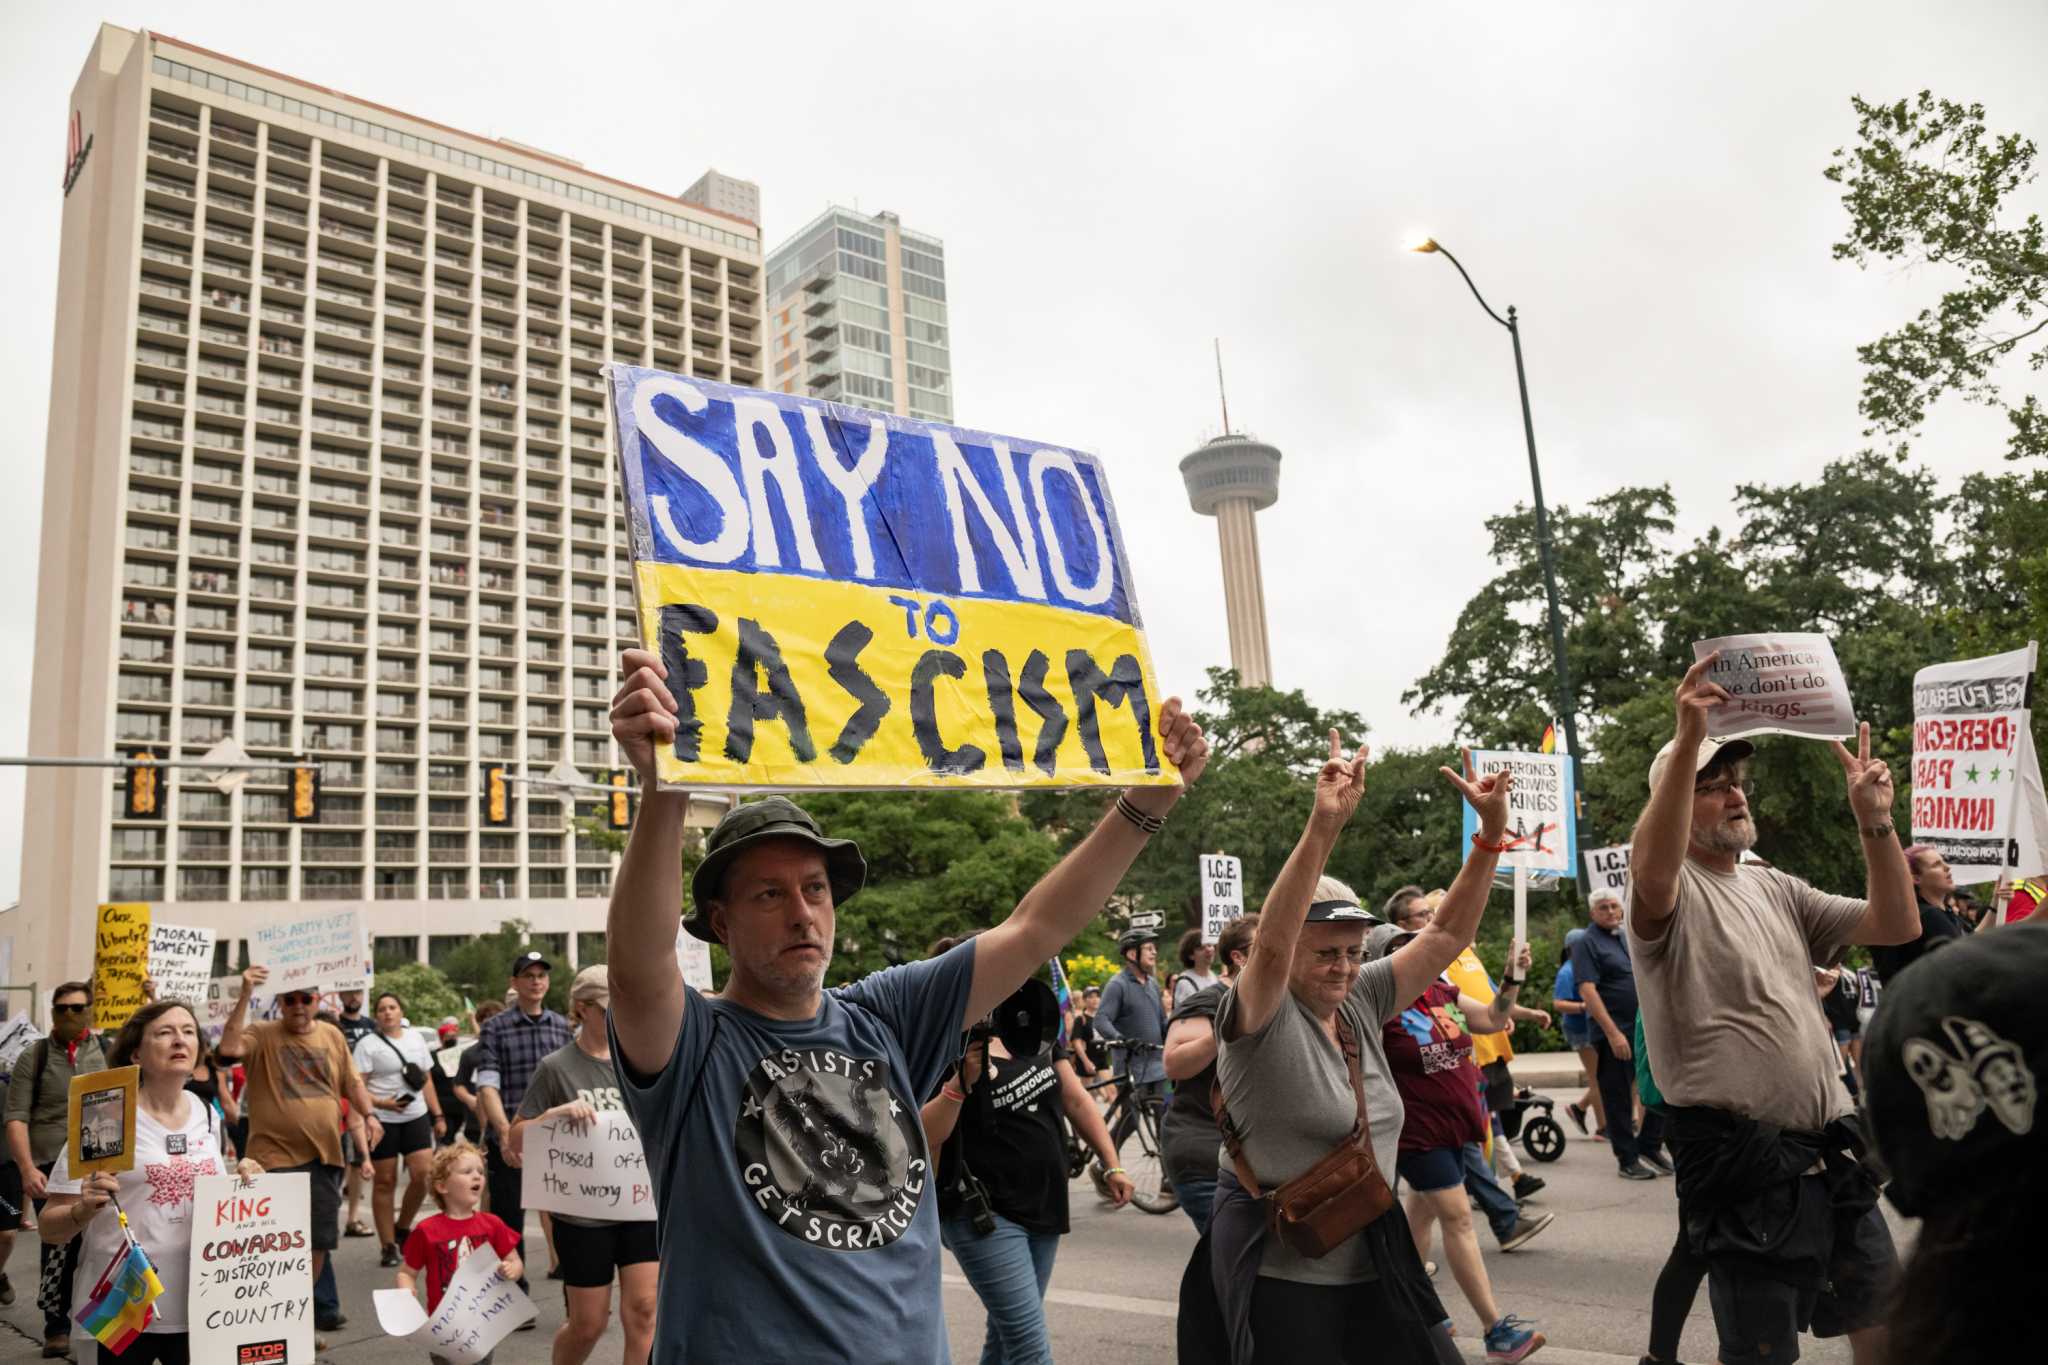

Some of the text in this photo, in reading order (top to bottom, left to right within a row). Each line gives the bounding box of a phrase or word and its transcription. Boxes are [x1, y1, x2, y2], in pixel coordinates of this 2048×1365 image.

[632, 376, 1113, 605] SAY NO
[889, 594, 960, 646] TO
[659, 603, 1161, 777] FASCISM
[1750, 675, 1797, 694] don't
[1803, 672, 1825, 689] do
[1741, 700, 1807, 719] kings.
[1483, 761, 1556, 776] NO THRONES
[1513, 777, 1557, 792] ROWNS
[1510, 793, 1558, 812] KINGS
[1208, 860, 1236, 879] I.C.E.
[1214, 882, 1232, 897] OUT
[1607, 873, 1627, 888] OU
[1209, 904, 1239, 918] OF OUR
[156, 927, 208, 943] MORAL
[257, 911, 353, 942] THIS ARMY VET
[315, 954, 357, 975] TRUMP!
[992, 1066, 1055, 1108] BIG ENOUGH
[231, 1178, 258, 1192] THE
[579, 1183, 621, 1207] wrong
[744, 1156, 926, 1248] GET SCRATCHES
[203, 1230, 305, 1262] COWARDS
[215, 1257, 306, 1283] DISTROYING
[235, 1281, 273, 1300] OUR
[206, 1297, 309, 1330] COUNTRY
[240, 1343, 284, 1359] STOP
